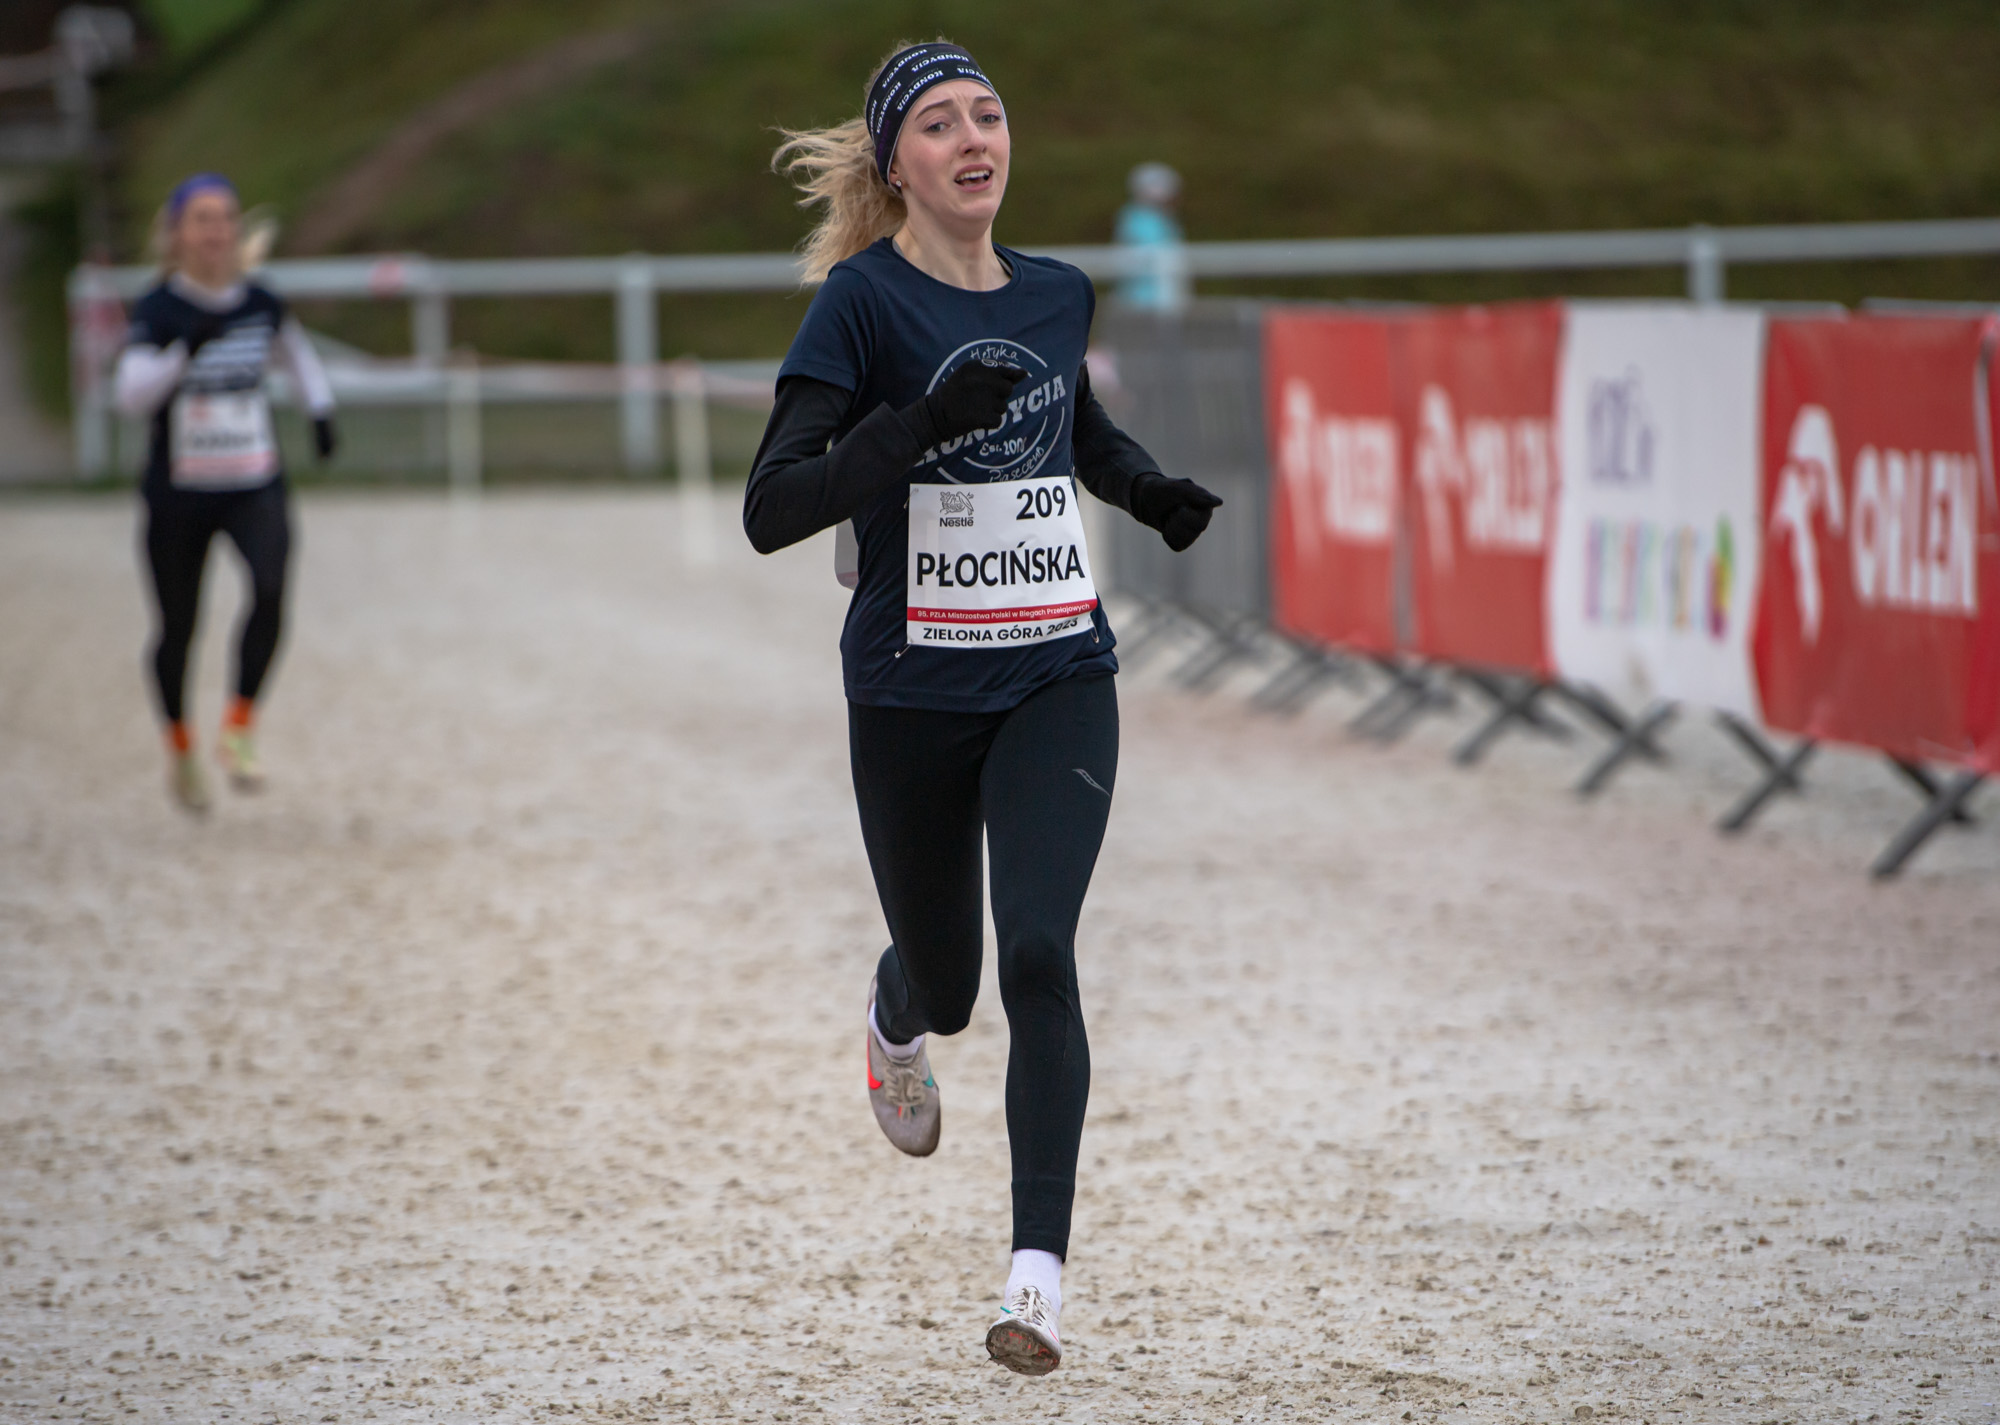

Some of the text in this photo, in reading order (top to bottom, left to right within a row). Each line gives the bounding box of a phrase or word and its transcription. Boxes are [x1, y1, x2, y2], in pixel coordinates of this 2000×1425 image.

[1016, 485, 1066, 520] 209
[1852, 444, 1979, 618] ORLEN
[917, 541, 1085, 588] PŁOCIŃSKA
[923, 617, 1078, 641] ZIELONA GÓRA 2023
[930, 611, 946, 619] PZLA
[948, 612, 990, 620] Mistrzostwa
[991, 611, 1011, 619] Polski
[1020, 609, 1046, 618] Biegach
